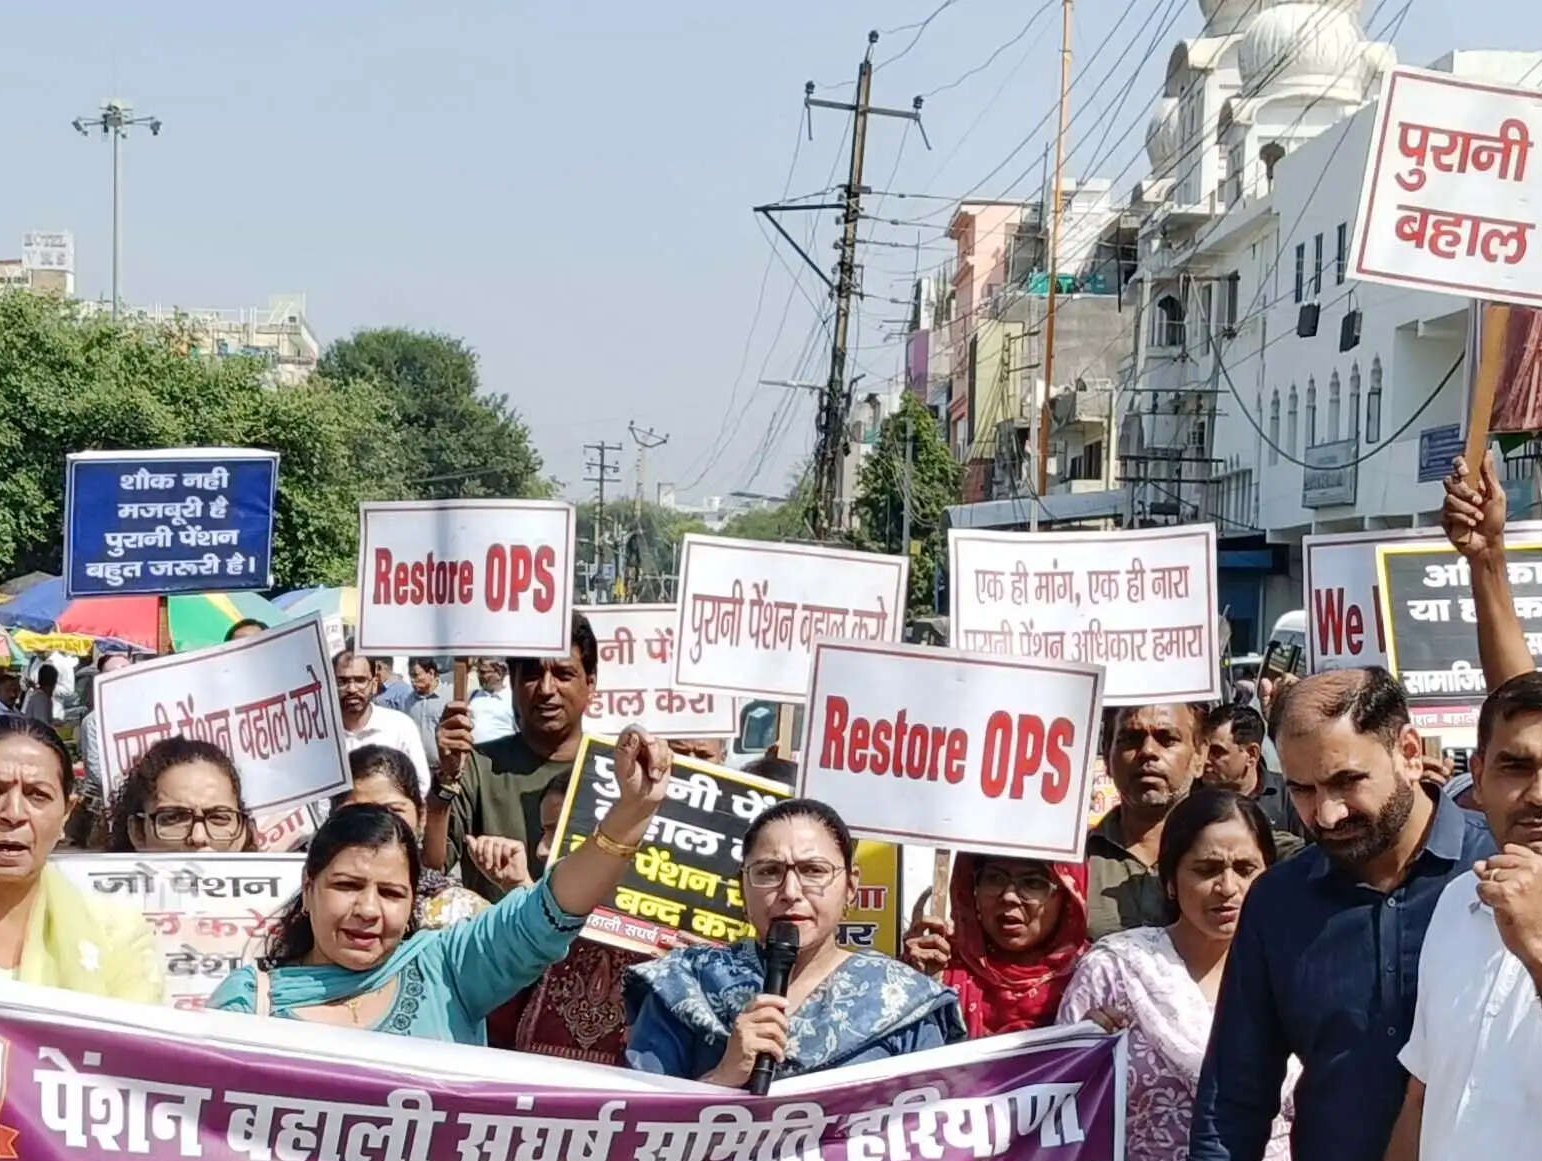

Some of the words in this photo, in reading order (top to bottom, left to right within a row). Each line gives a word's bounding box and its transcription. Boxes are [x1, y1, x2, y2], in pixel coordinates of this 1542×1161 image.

[1395, 119, 1533, 191] पुरानी
[1394, 204, 1536, 264] बहाल
[120, 467, 176, 491] शौक
[182, 466, 230, 491] नही
[117, 495, 203, 526] मजबूरी
[208, 494, 228, 519] है
[104, 526, 172, 559] पुरानी
[179, 525, 239, 549] पेंशन
[86, 561, 143, 585] बहुत
[147, 553, 219, 578] जरूरी
[373, 547, 474, 606] Restore
[484, 543, 556, 614] OPS
[975, 569, 1005, 605] एक
[1010, 560, 1029, 605] ही
[1087, 569, 1120, 603] एक
[1126, 557, 1145, 603] ही
[1151, 565, 1190, 600] नारा
[690, 578, 745, 665] पुरानी
[748, 579, 797, 651] पेंशन
[1314, 586, 1364, 656] We
[1407, 599, 1451, 622] या
[1458, 598, 1478, 623] ह
[1019, 618, 1065, 661] पेंशन
[1071, 617, 1147, 663] अधिकार
[1151, 624, 1203, 663] हमारा
[1403, 659, 1487, 694] सामाजि
[234, 692, 292, 761] बहाल
[289, 664, 328, 745] करो
[584, 688, 648, 719] हाल
[818, 694, 968, 782] Restore
[979, 709, 1075, 805] OPS
[88, 862, 158, 894] जो
[635, 845, 721, 898] पेंशन
[615, 886, 687, 927] बन्द
[33, 1046, 213, 1157] पेंशन
